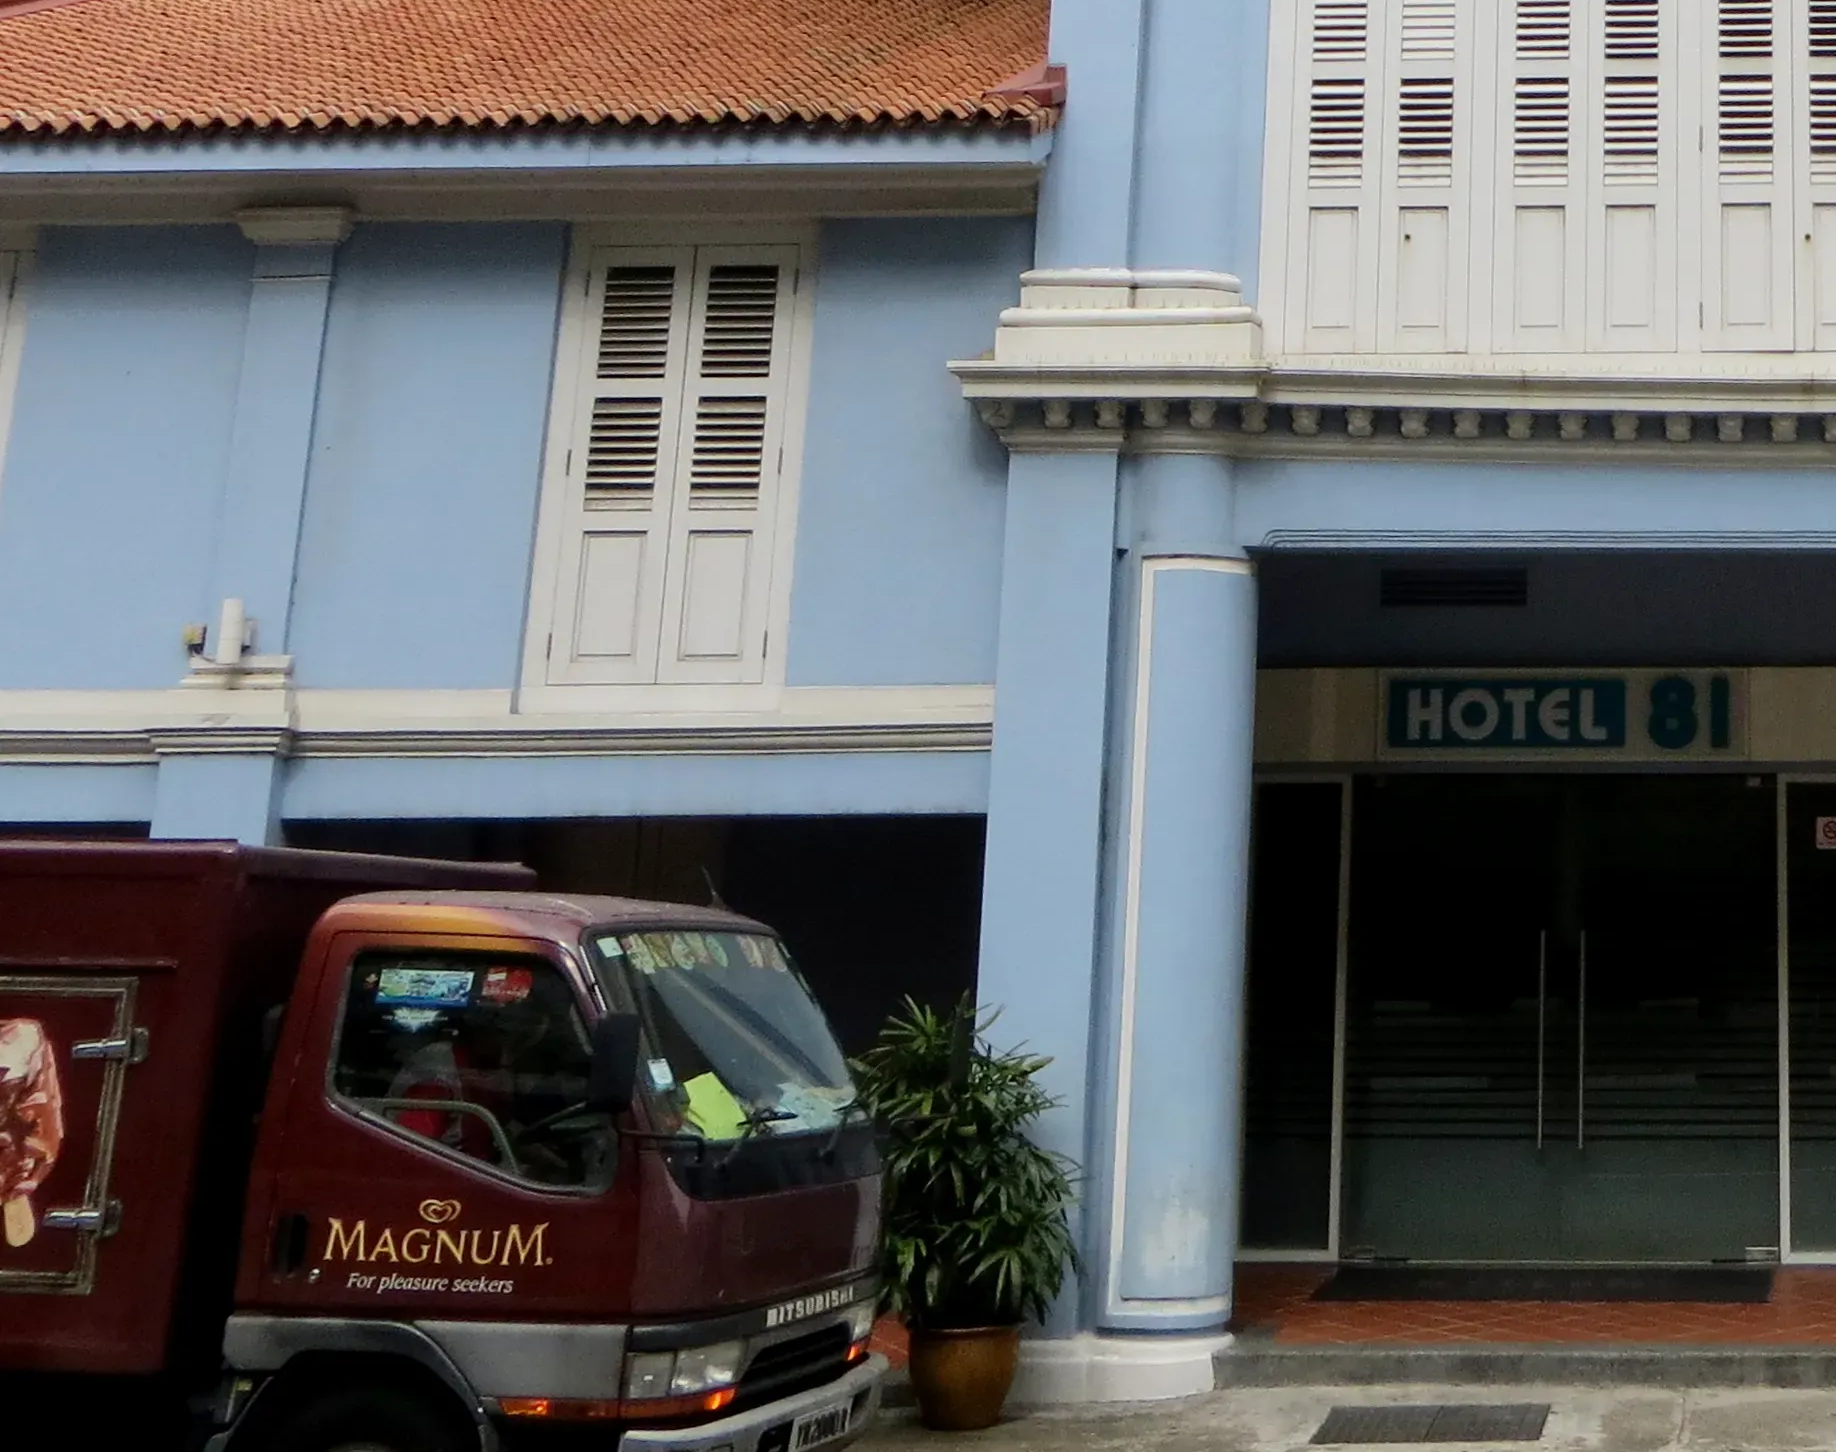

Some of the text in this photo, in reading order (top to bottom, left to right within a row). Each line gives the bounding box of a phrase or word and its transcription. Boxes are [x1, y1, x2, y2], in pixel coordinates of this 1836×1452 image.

[1406, 676, 1730, 749] HOTEL 81
[322, 1216, 550, 1266] MAGNUM
[346, 1272, 514, 1295] For pleasure seekers
[766, 1286, 854, 1328] MITSUBISHI
